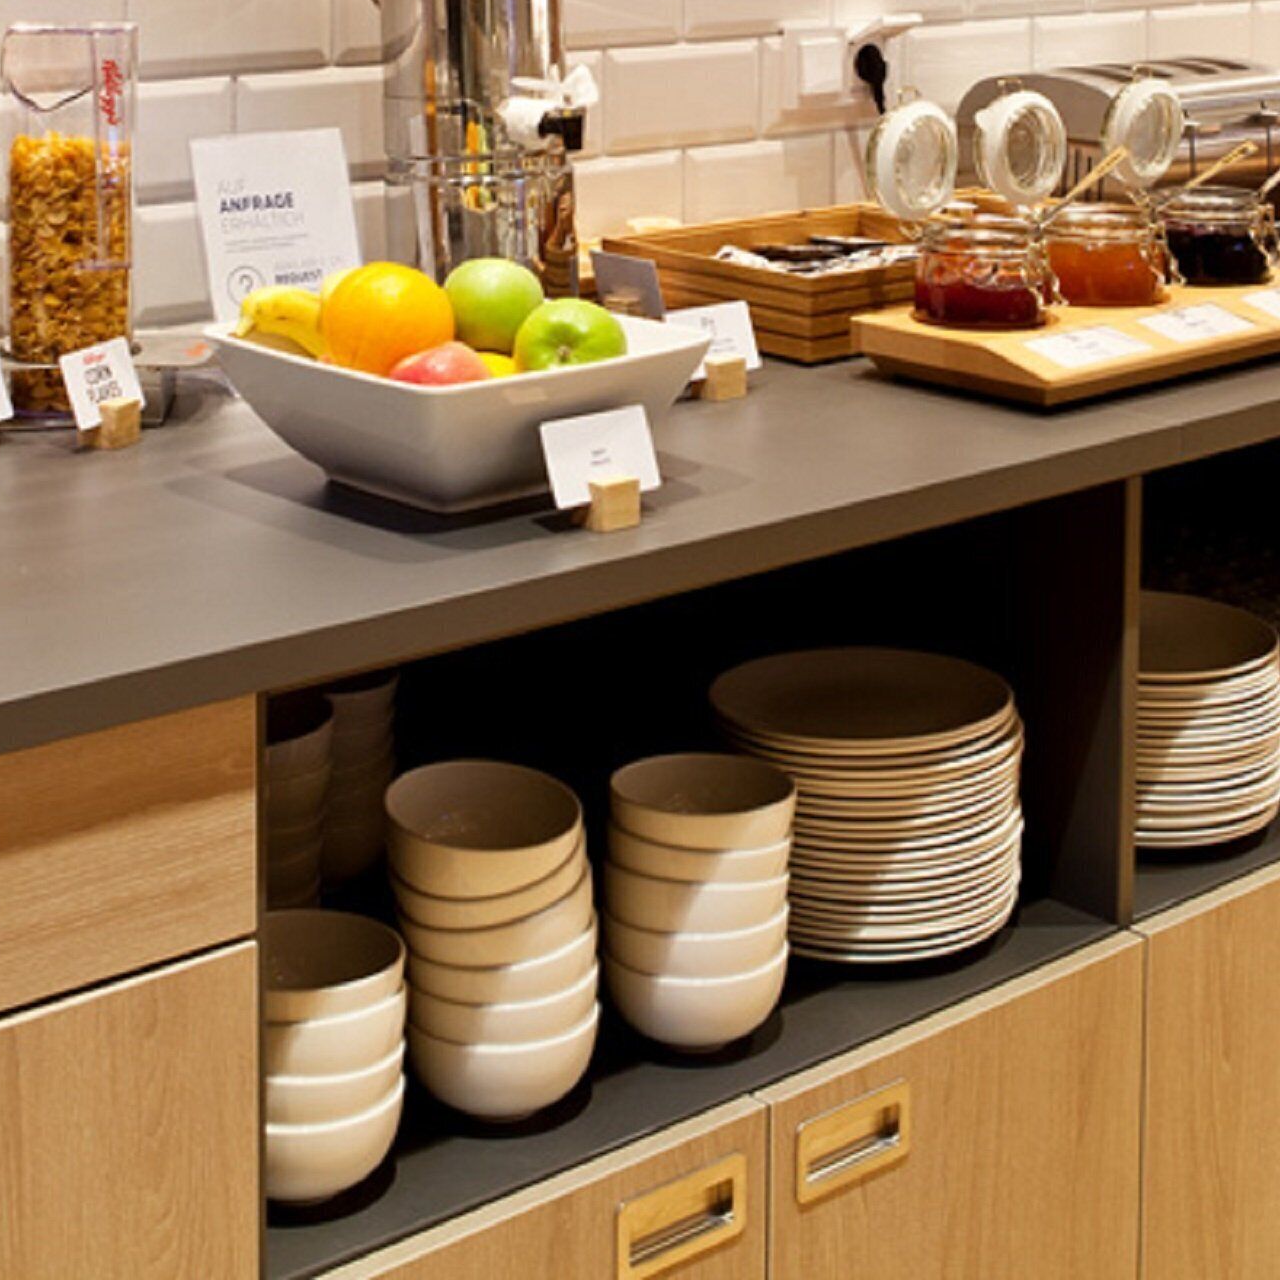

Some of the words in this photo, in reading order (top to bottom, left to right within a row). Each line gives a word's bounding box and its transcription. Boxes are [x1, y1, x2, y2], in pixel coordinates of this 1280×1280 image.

[220, 191, 294, 213] ANFRAGE
[274, 268, 322, 284] REQUEST
[84, 365, 112, 385] CORN
